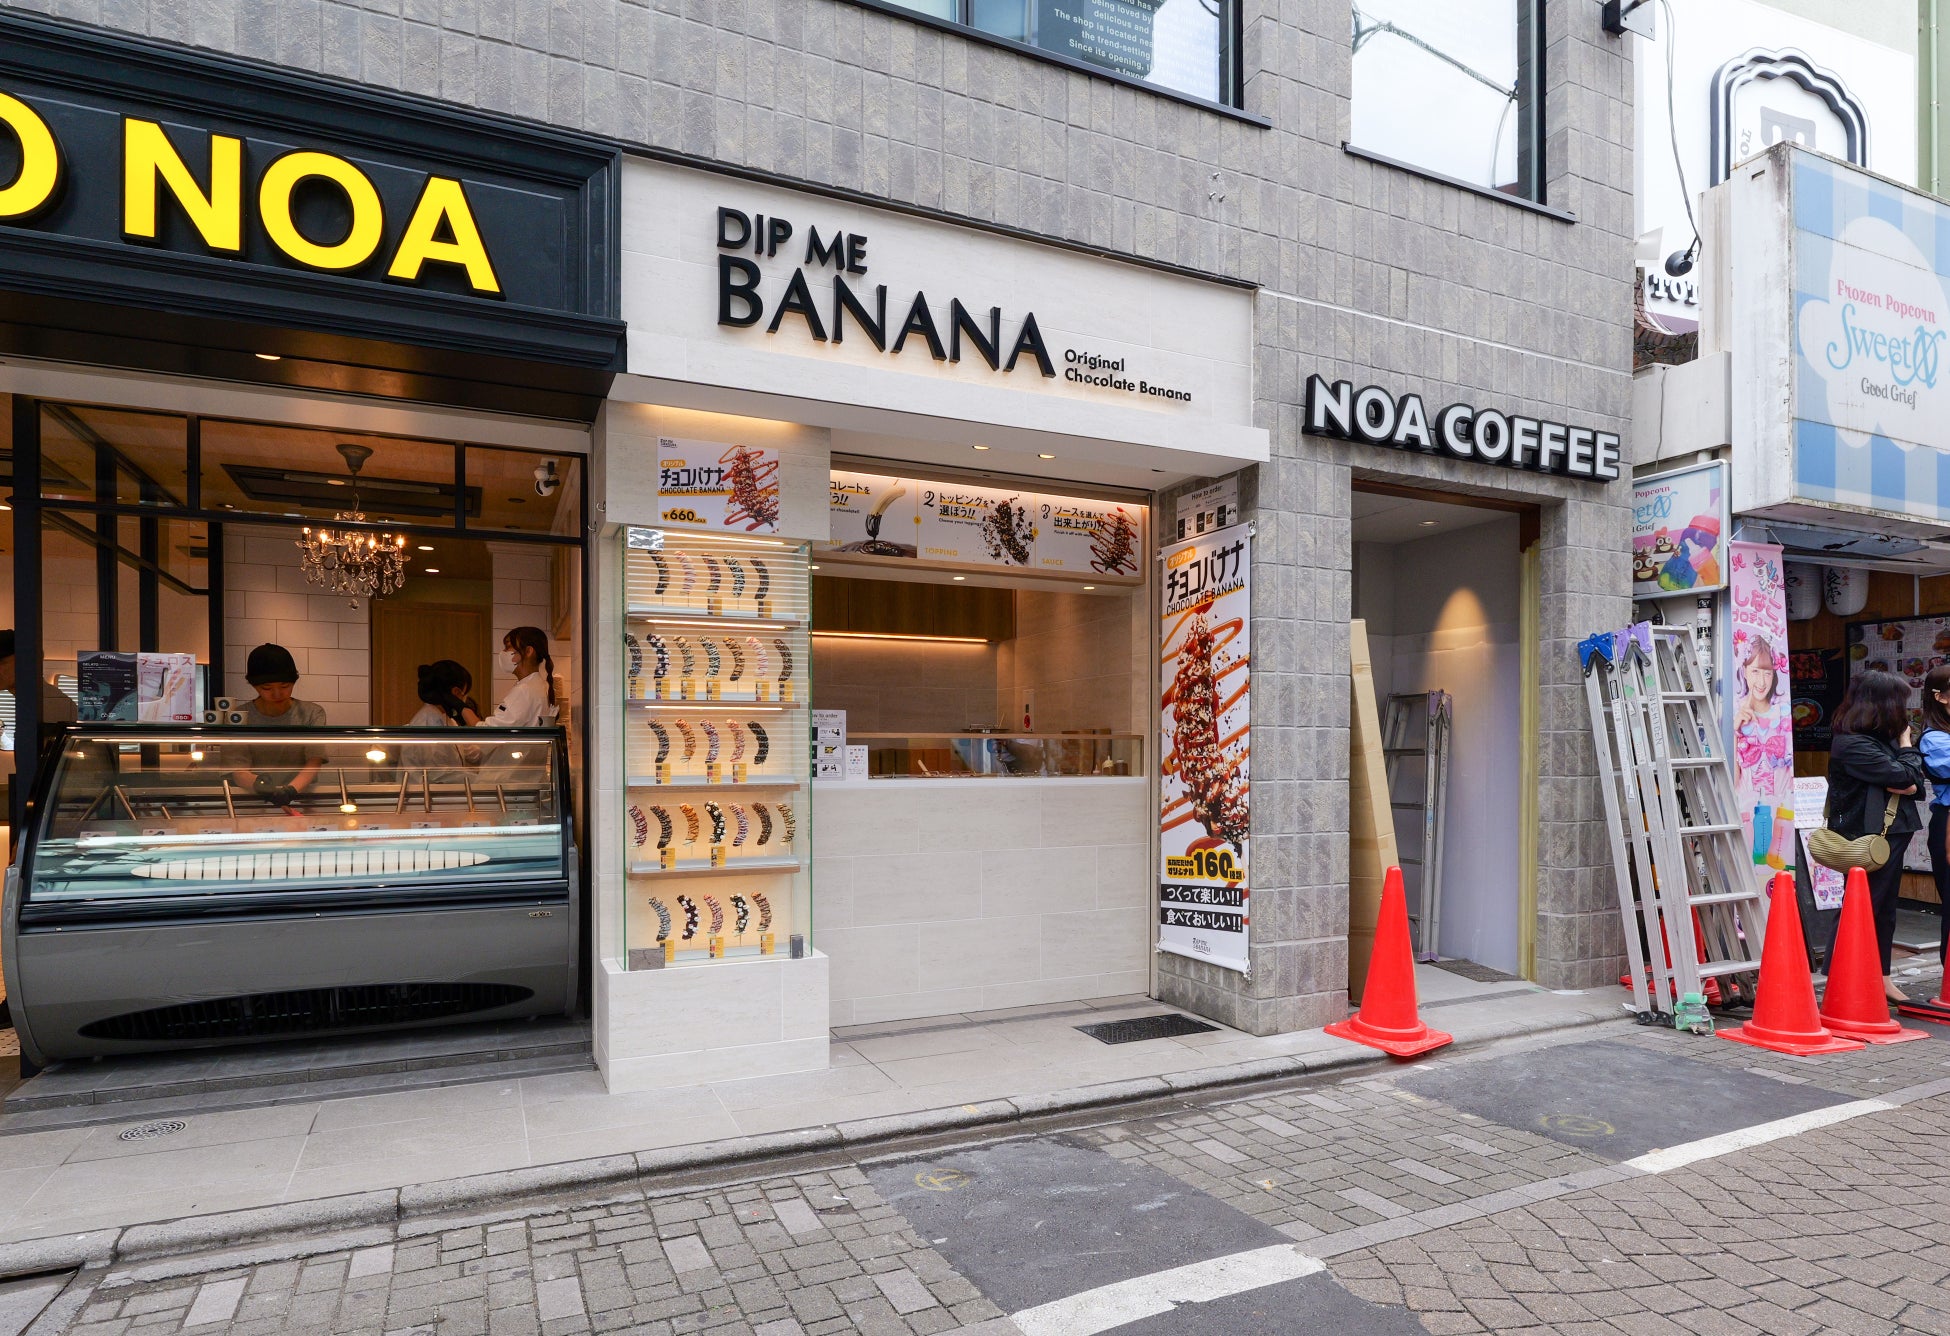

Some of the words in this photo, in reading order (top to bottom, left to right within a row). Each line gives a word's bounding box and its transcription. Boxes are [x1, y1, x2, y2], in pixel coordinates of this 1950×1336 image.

[1054, 8, 1070, 20] The
[1072, 15, 1094, 29] shop
[1096, 22, 1104, 31] is
[1106, 26, 1137, 42] located
[1139, 38, 1153, 48] nea
[1094, 10, 1132, 28] delicious
[1134, 24, 1149, 34] and
[1117, 5, 1140, 19] loved
[1142, 12, 1152, 24] by
[1069, 38, 1093, 53] Since
[1095, 46, 1106, 57] its
[1108, 52, 1144, 71] opening,
[1081, 30, 1095, 41] the
[1097, 36, 1151, 60] trend-setting
[122, 114, 503, 297] NOA
[717, 206, 793, 257] DIP
[804, 224, 867, 275] ME
[1837, 279, 1882, 307] Frozen
[1886, 294, 1936, 324] Popcorn
[717, 253, 1056, 379] BANANA
[1064, 348, 1125, 372] Original
[1064, 367, 1135, 391] Chocolate
[1139, 380, 1192, 401] Banana
[1861, 378, 1888, 399] Good
[1890, 385, 1917, 410] Grief
[1306, 374, 1432, 448] NOA
[1436, 403, 1620, 480] COFFEE
[661, 467, 725, 487] チョコバナナ
[661, 486, 698, 495] CHOCOLATE
[700, 486, 726, 494] BANANA
[923, 490, 935, 508] 2
[1635, 486, 1670, 498] Popcorn
[1636, 523, 1654, 532] Grief
[925, 547, 958, 556] TOPPING
[1042, 558, 1064, 566] SAUCE
[1167, 540, 1244, 603] チョコバナナ
[1166, 590, 1209, 616] CHOCOLATE
[1212, 576, 1245, 600] BANANA
[1194, 851, 1232, 879] 160
[1166, 886, 1240, 906] つくって楽しい!!
[1166, 908, 1242, 931] 食べておいしい!!
